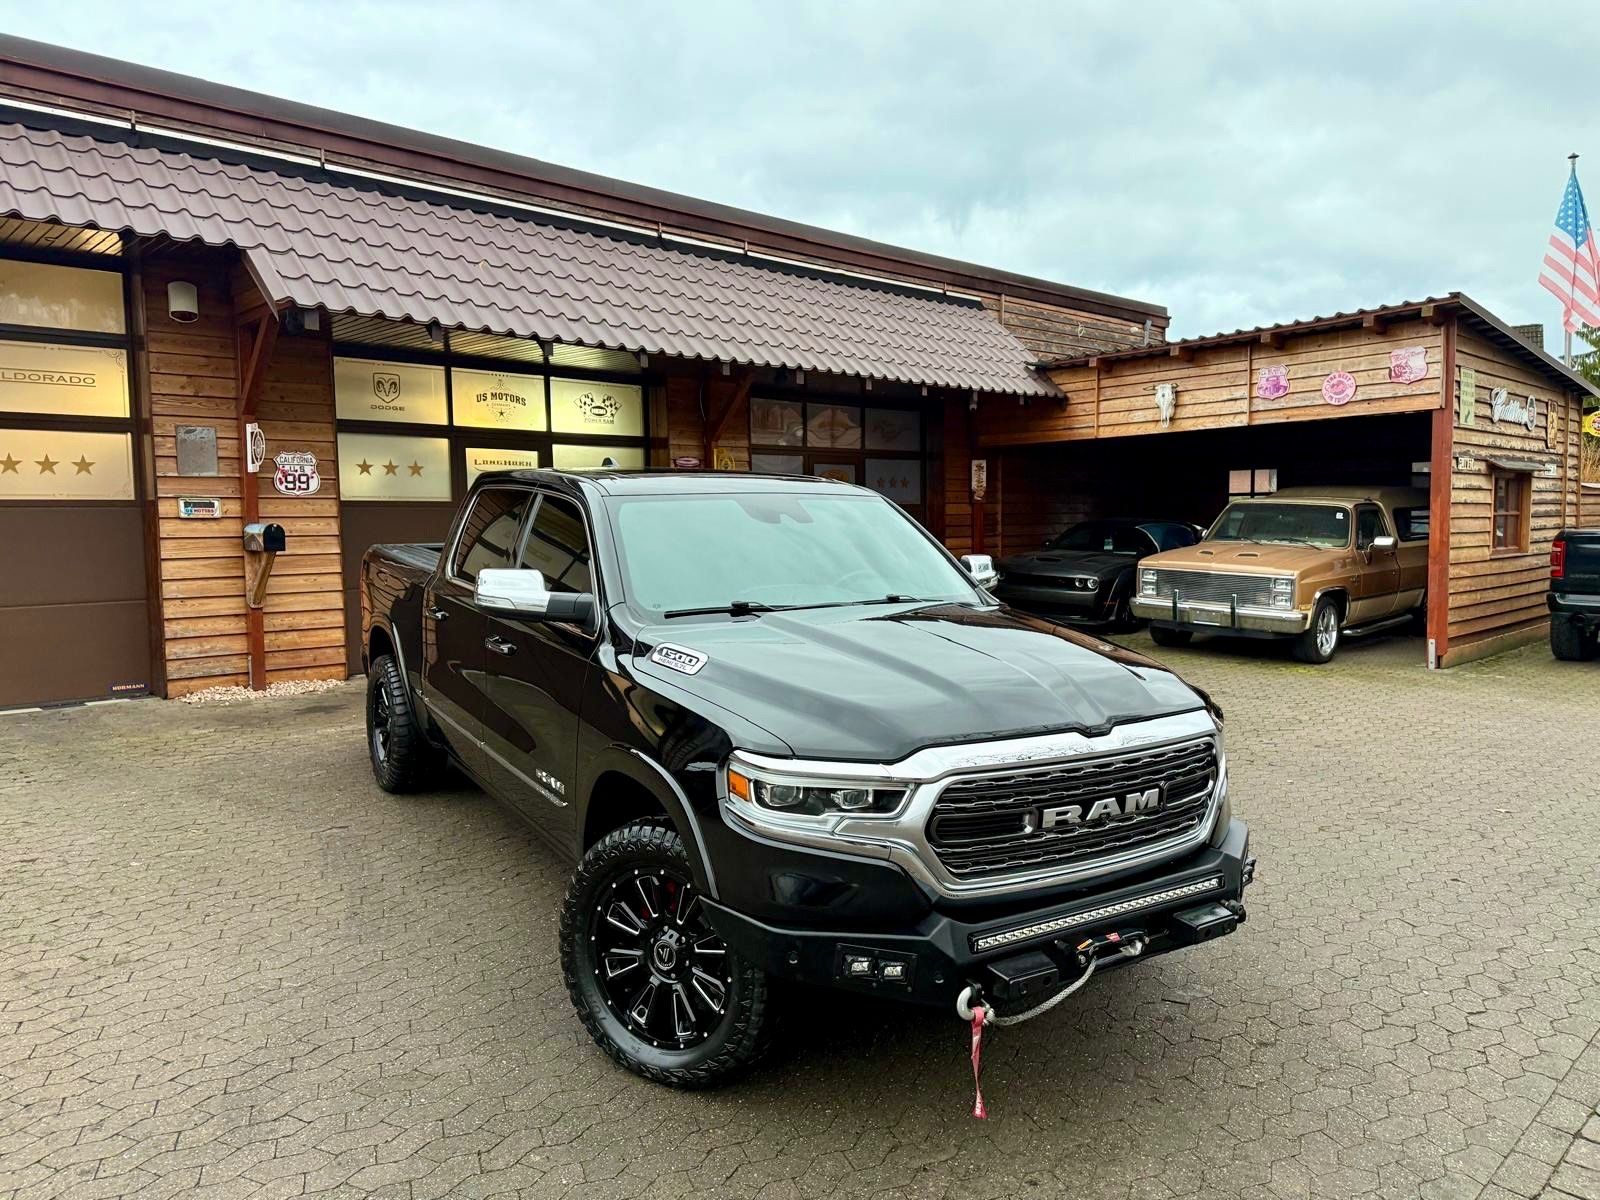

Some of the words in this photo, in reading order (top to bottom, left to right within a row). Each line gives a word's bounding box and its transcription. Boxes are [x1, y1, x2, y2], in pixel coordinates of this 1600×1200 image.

[476, 392, 488, 403] US
[490, 391, 527, 407] MOTORS
[370, 404, 406, 412] DODGE
[279, 456, 313, 464] CALIFORNIA
[284, 473, 310, 491] 99
[662, 648, 698, 666] 1500
[1042, 788, 1160, 829] RAM
